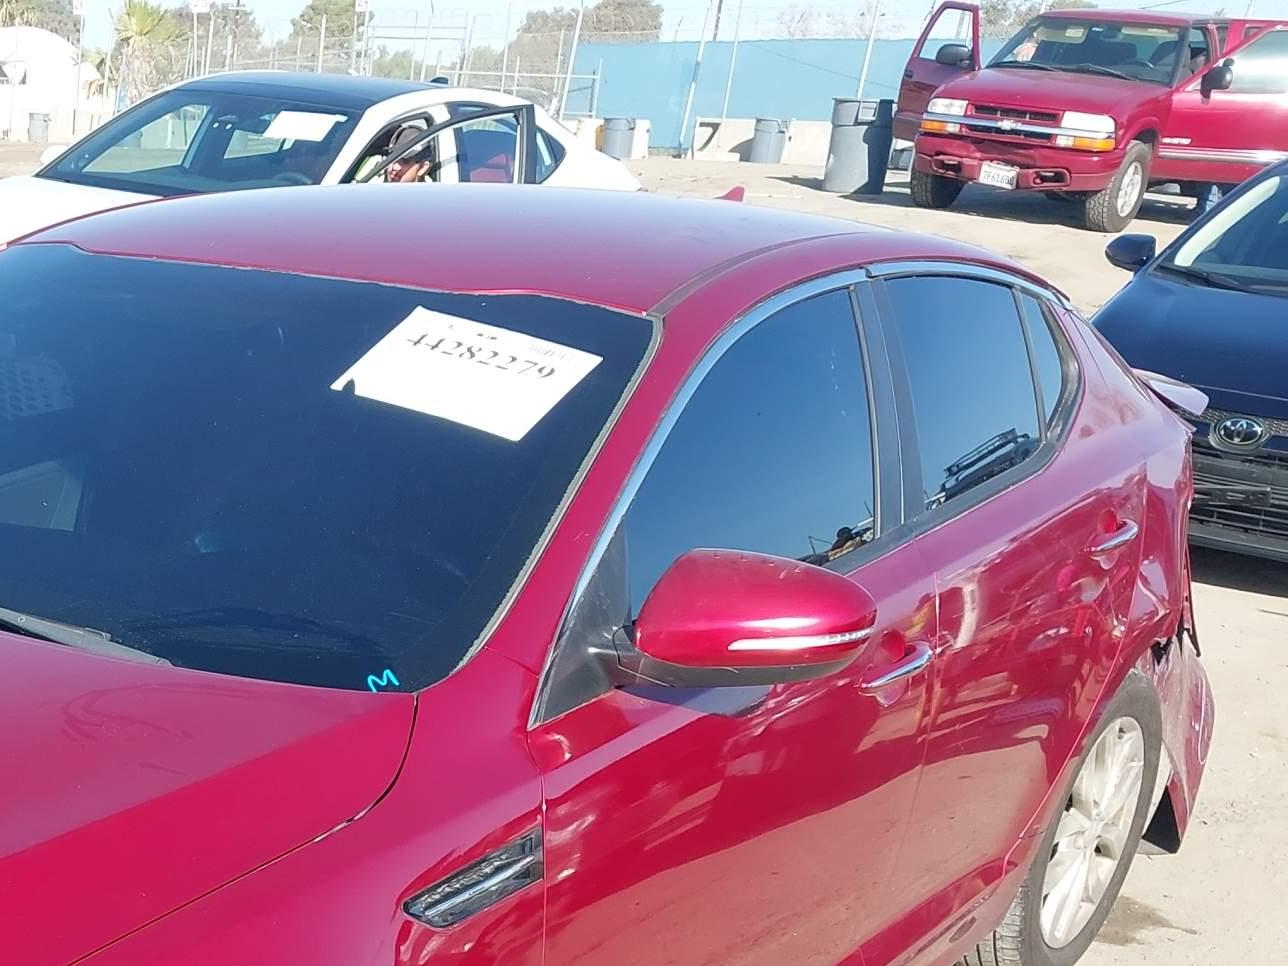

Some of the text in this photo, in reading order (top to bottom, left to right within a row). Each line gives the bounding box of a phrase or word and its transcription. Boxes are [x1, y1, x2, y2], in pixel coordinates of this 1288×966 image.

[698, 122, 721, 151] 7
[406, 332, 557, 380] 44282279
[367, 668, 400, 693] M
